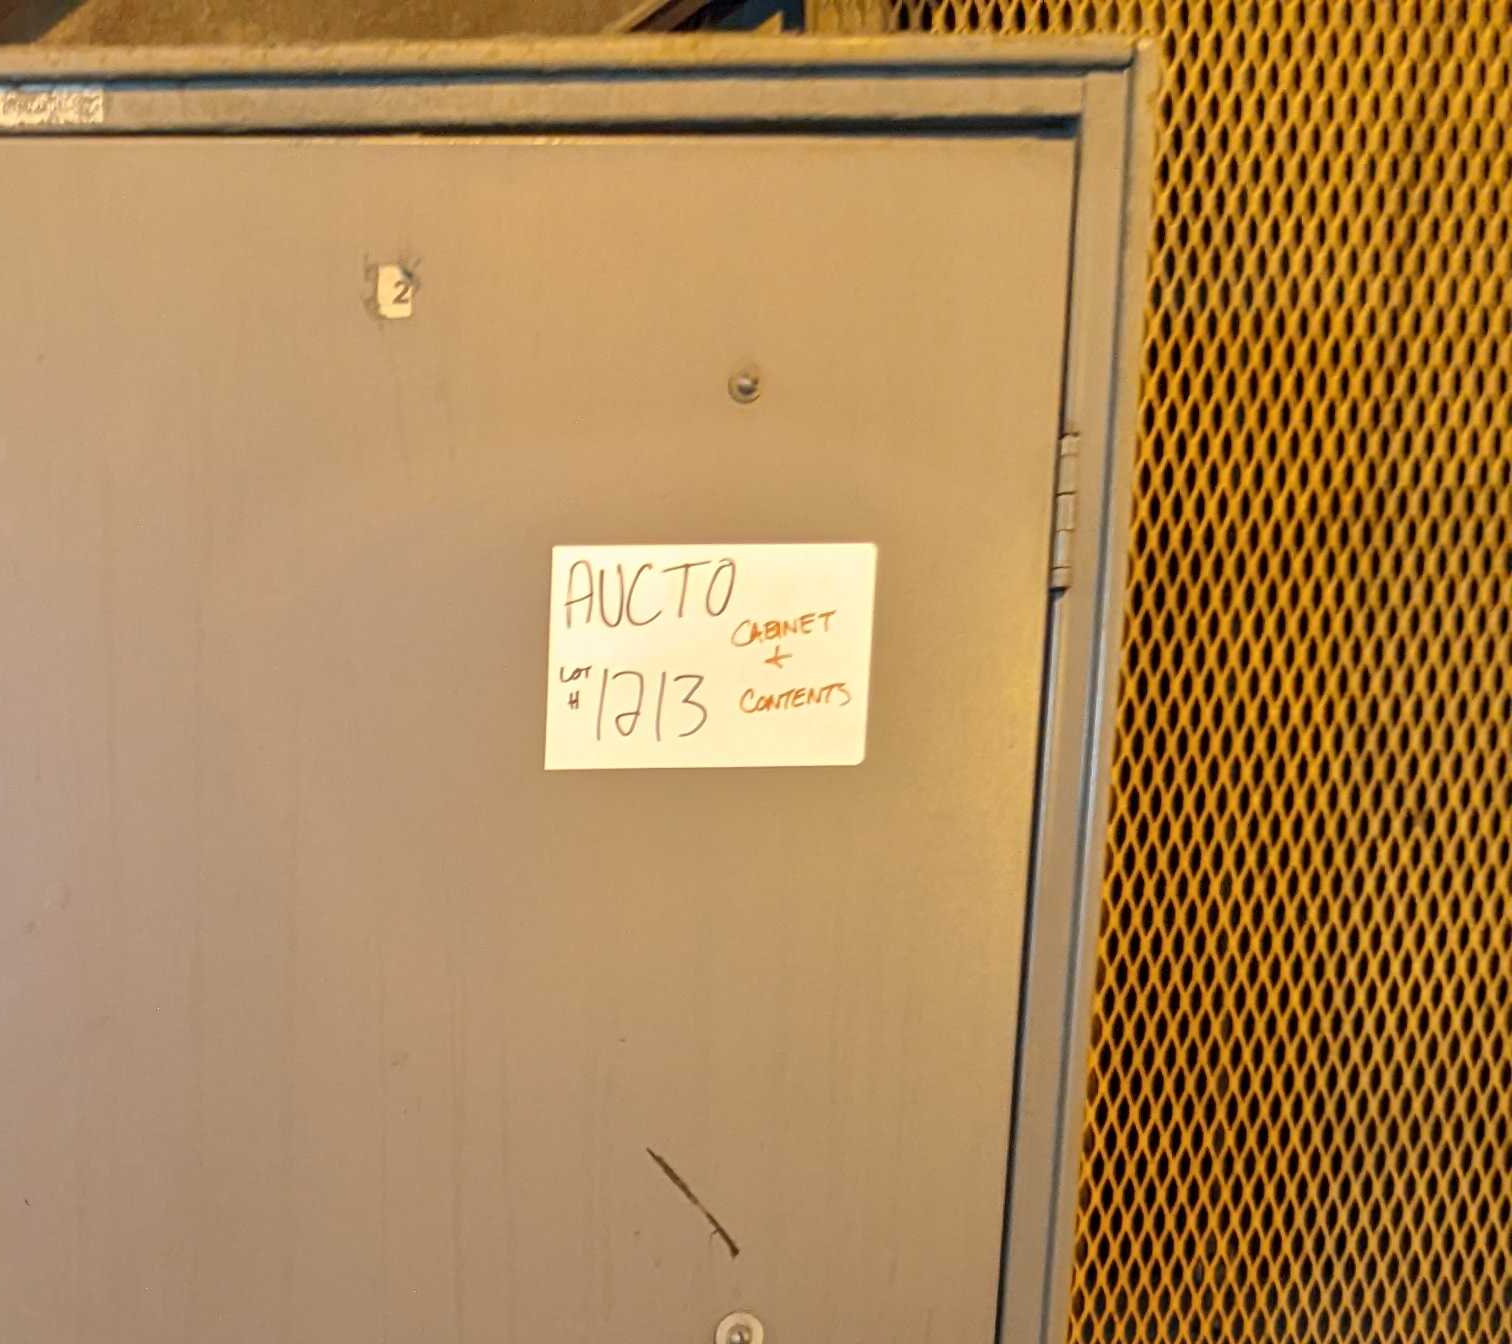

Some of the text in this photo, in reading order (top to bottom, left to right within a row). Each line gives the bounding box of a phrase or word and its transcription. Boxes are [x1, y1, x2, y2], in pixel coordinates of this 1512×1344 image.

[392, 280, 410, 304] 2
[563, 557, 736, 630] AUCTO
[559, 664, 593, 684] LOT
[738, 681, 852, 714] CONTENTS
